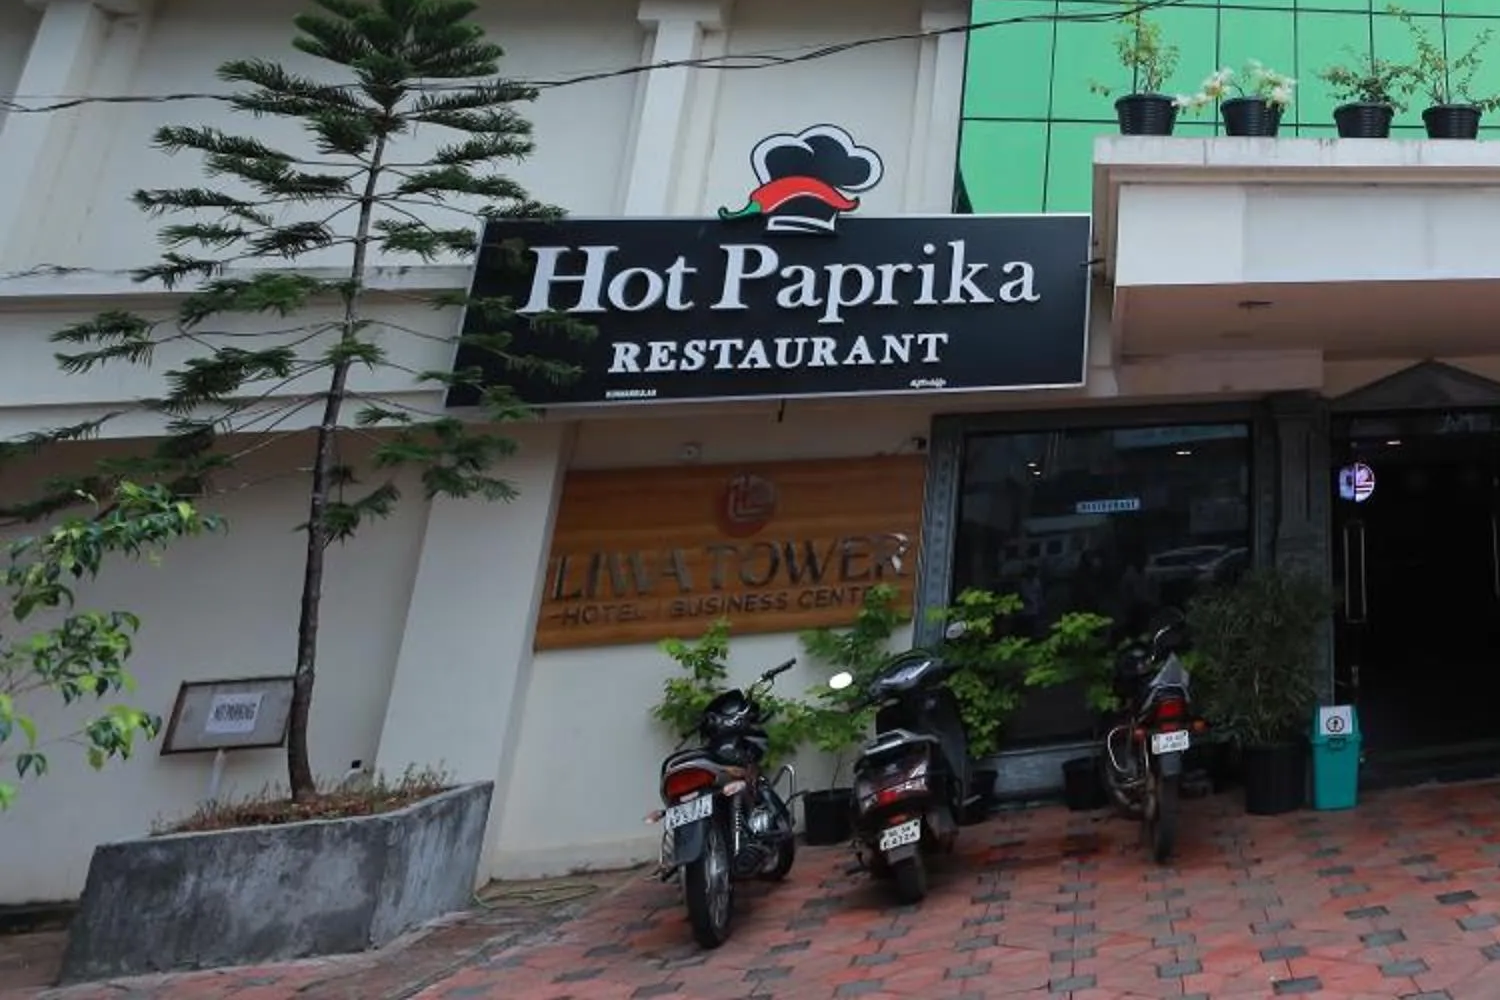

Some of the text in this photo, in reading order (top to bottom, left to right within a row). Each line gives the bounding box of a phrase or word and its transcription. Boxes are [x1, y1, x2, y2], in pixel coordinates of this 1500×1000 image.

[514, 238, 1041, 324] Hot Paprika
[607, 332, 949, 374] RESTAURANT
[562, 602, 646, 626] HOTEL
[670, 591, 788, 620] BUSINESS
